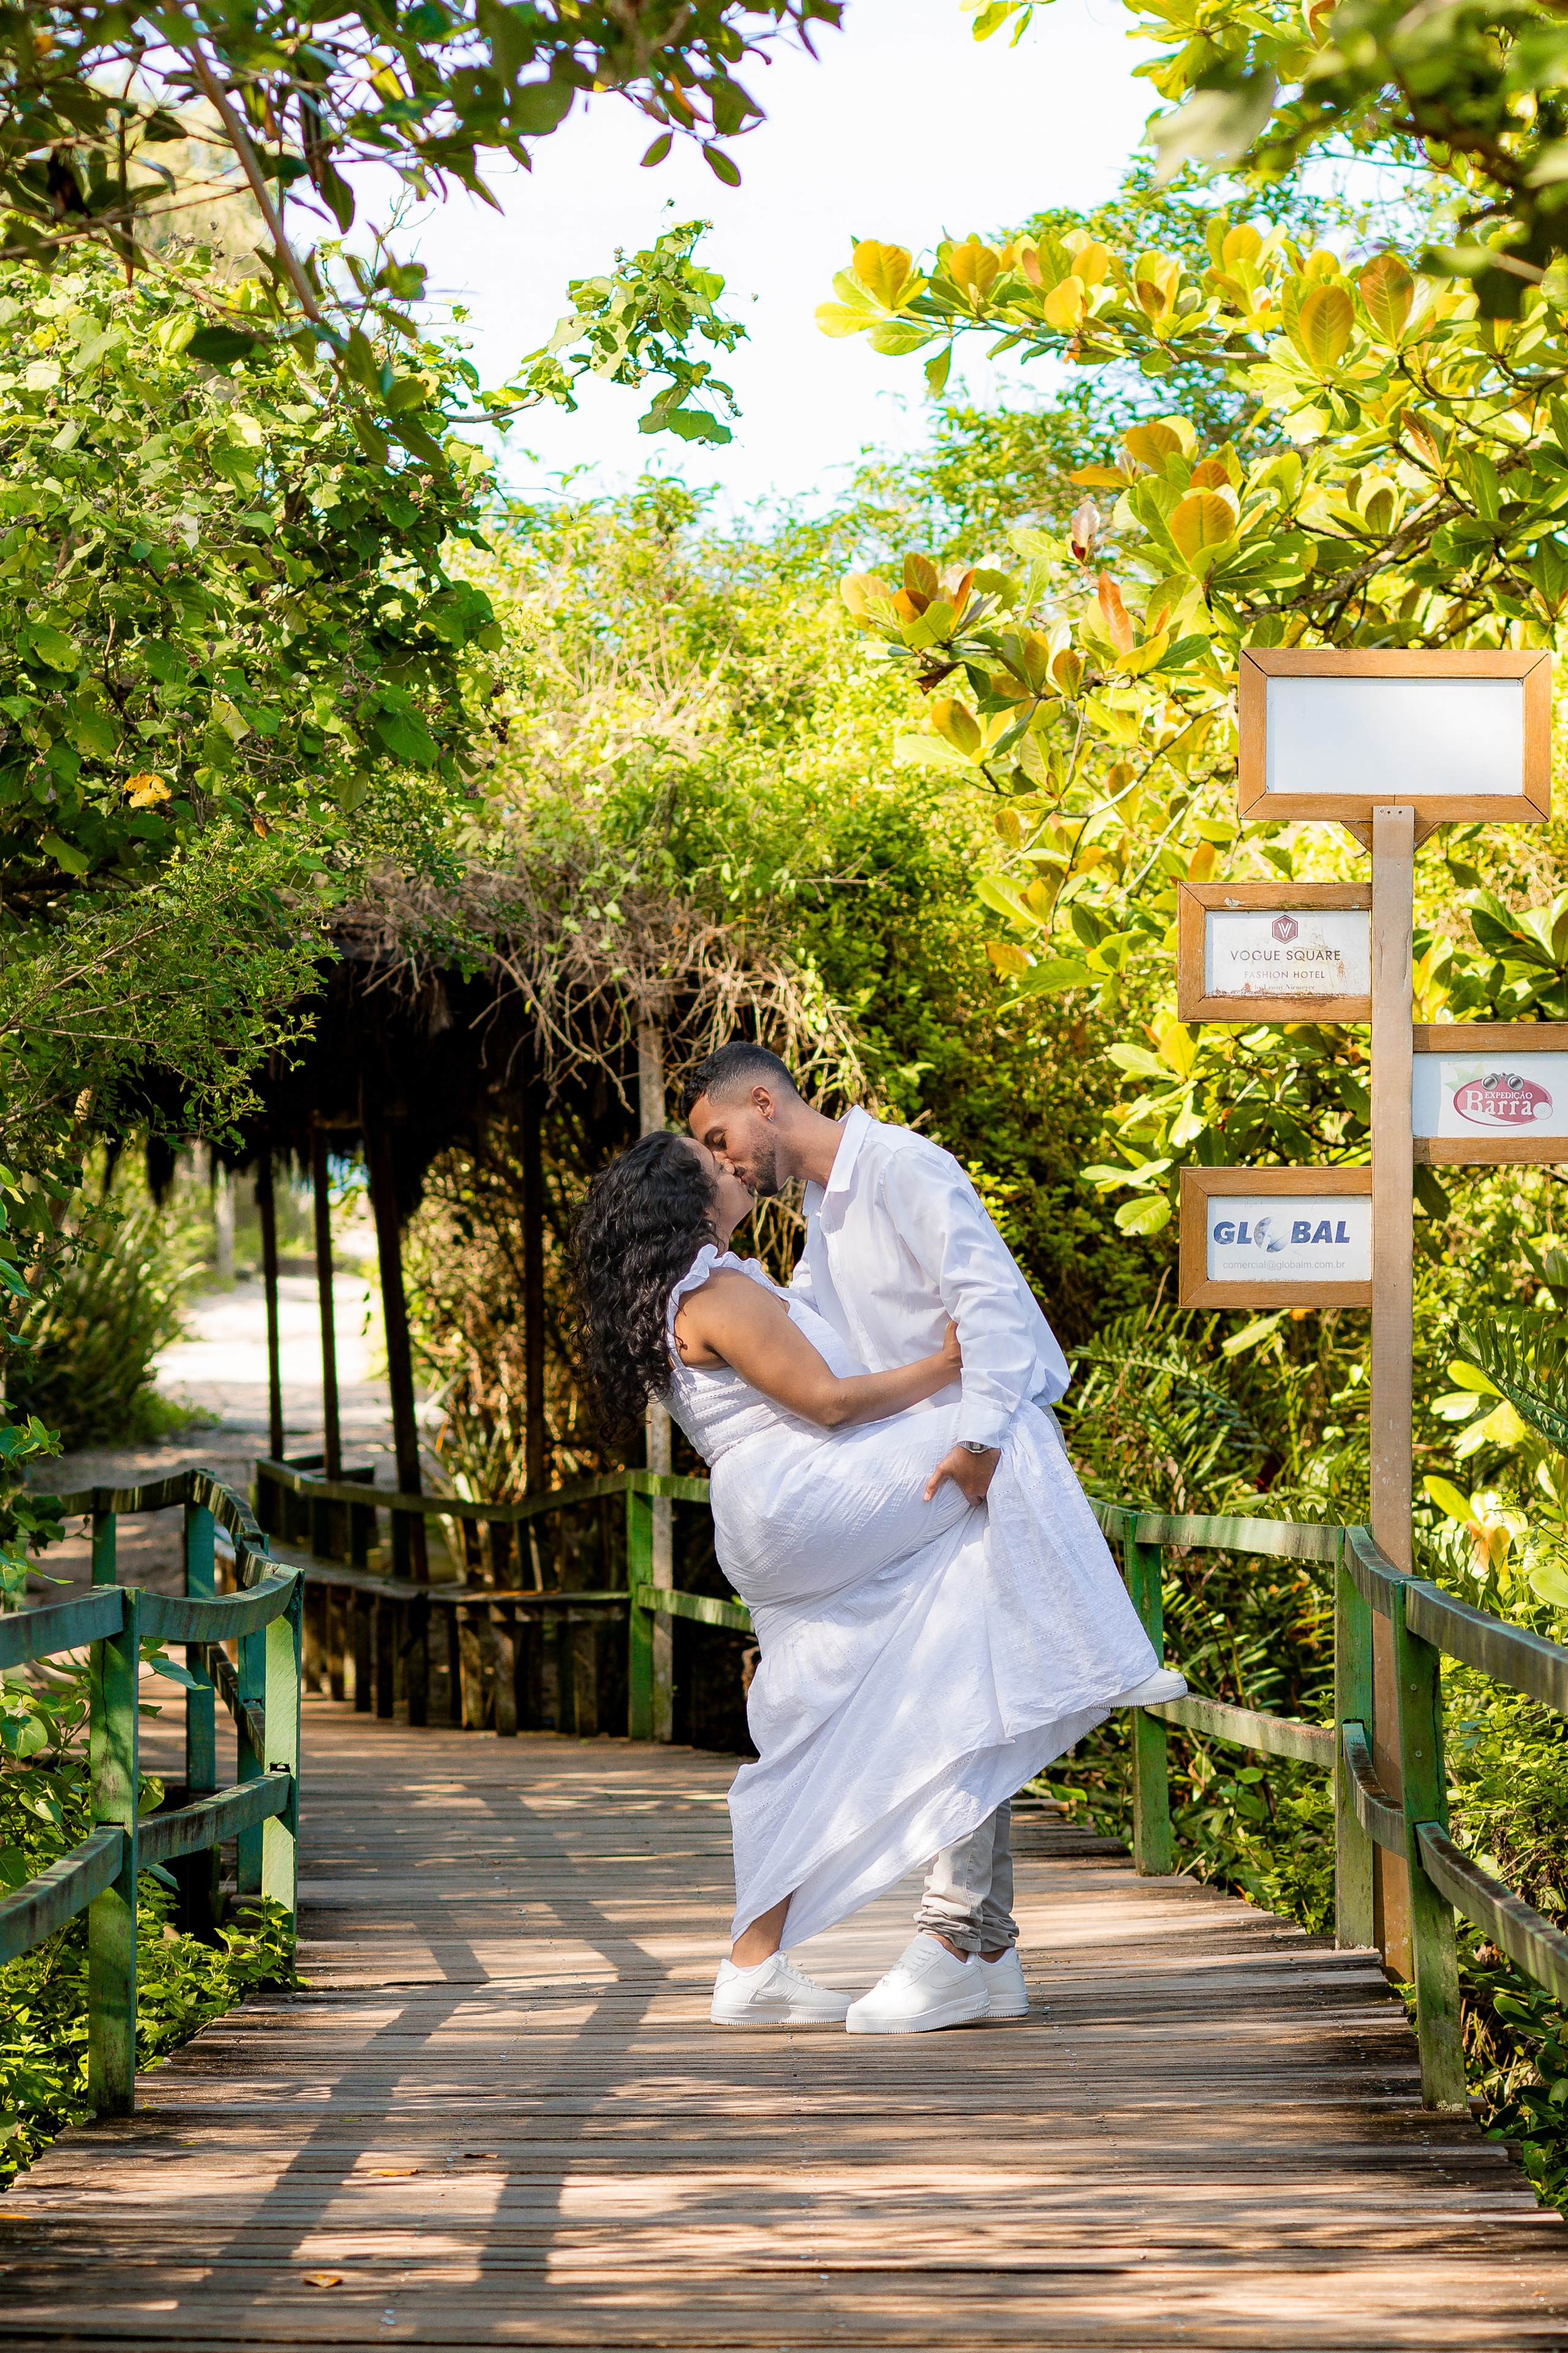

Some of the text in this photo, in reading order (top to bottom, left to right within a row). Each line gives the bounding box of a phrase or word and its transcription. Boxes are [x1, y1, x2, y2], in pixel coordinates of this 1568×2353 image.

[1231, 950, 1340, 961] VOGUE SQUARE
[1485, 1090, 1532, 1100] EXPEDIÇÃO
[1465, 1090, 1532, 1116] Barra
[1213, 1216, 1351, 1253] GLOBAL
[1223, 1260, 1345, 1271] comercial@globalm.com.br
